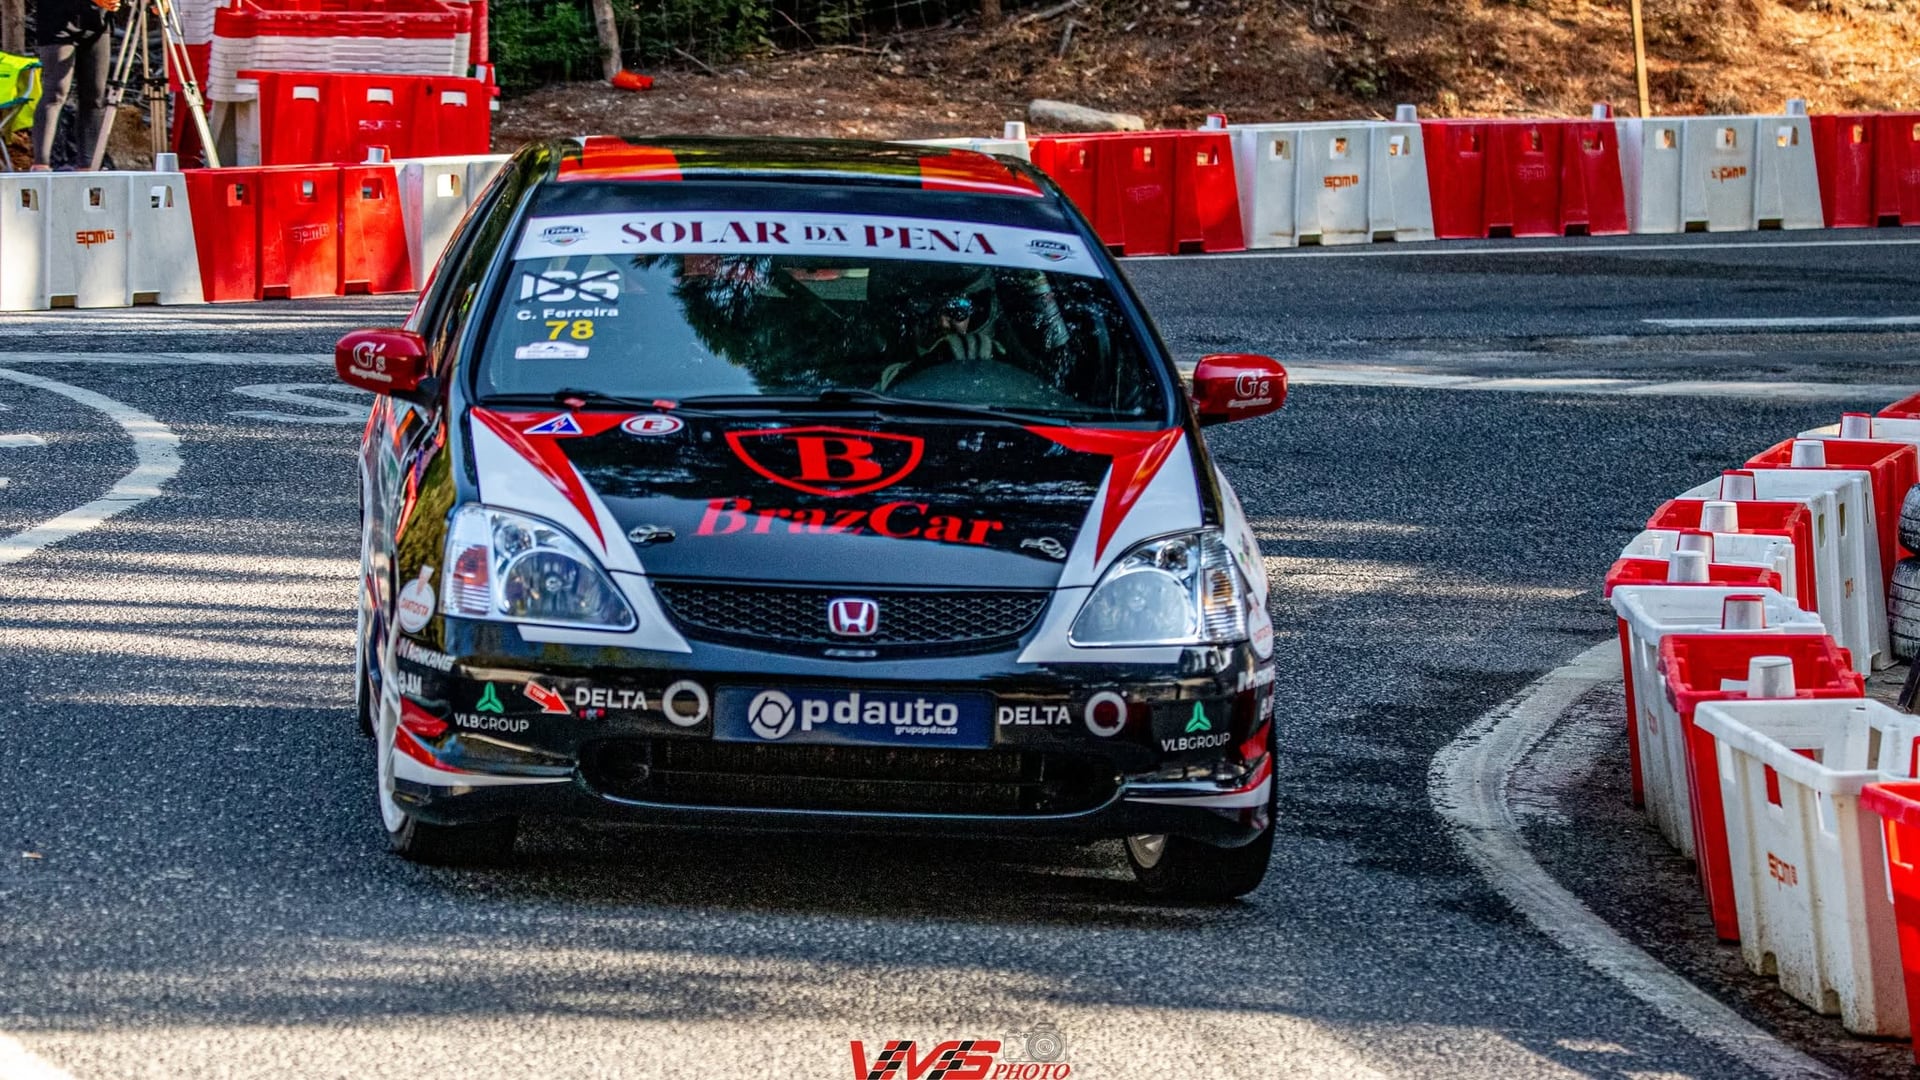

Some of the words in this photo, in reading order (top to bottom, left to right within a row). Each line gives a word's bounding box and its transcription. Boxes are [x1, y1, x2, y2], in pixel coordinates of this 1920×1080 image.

[621, 221, 790, 244] SOLAR
[804, 226, 848, 241] DA
[864, 225, 997, 255] PENA
[517, 309, 537, 320] C.
[543, 307, 619, 319] Ferreira
[545, 319, 595, 341] 78
[691, 496, 1004, 546] BrazCar
[574, 686, 648, 711] DELTA
[454, 712, 530, 733] VLBGROUP
[801, 693, 959, 731] pdauto
[999, 706, 1071, 725] DELTA
[1161, 732, 1231, 752] VLBGROUP
